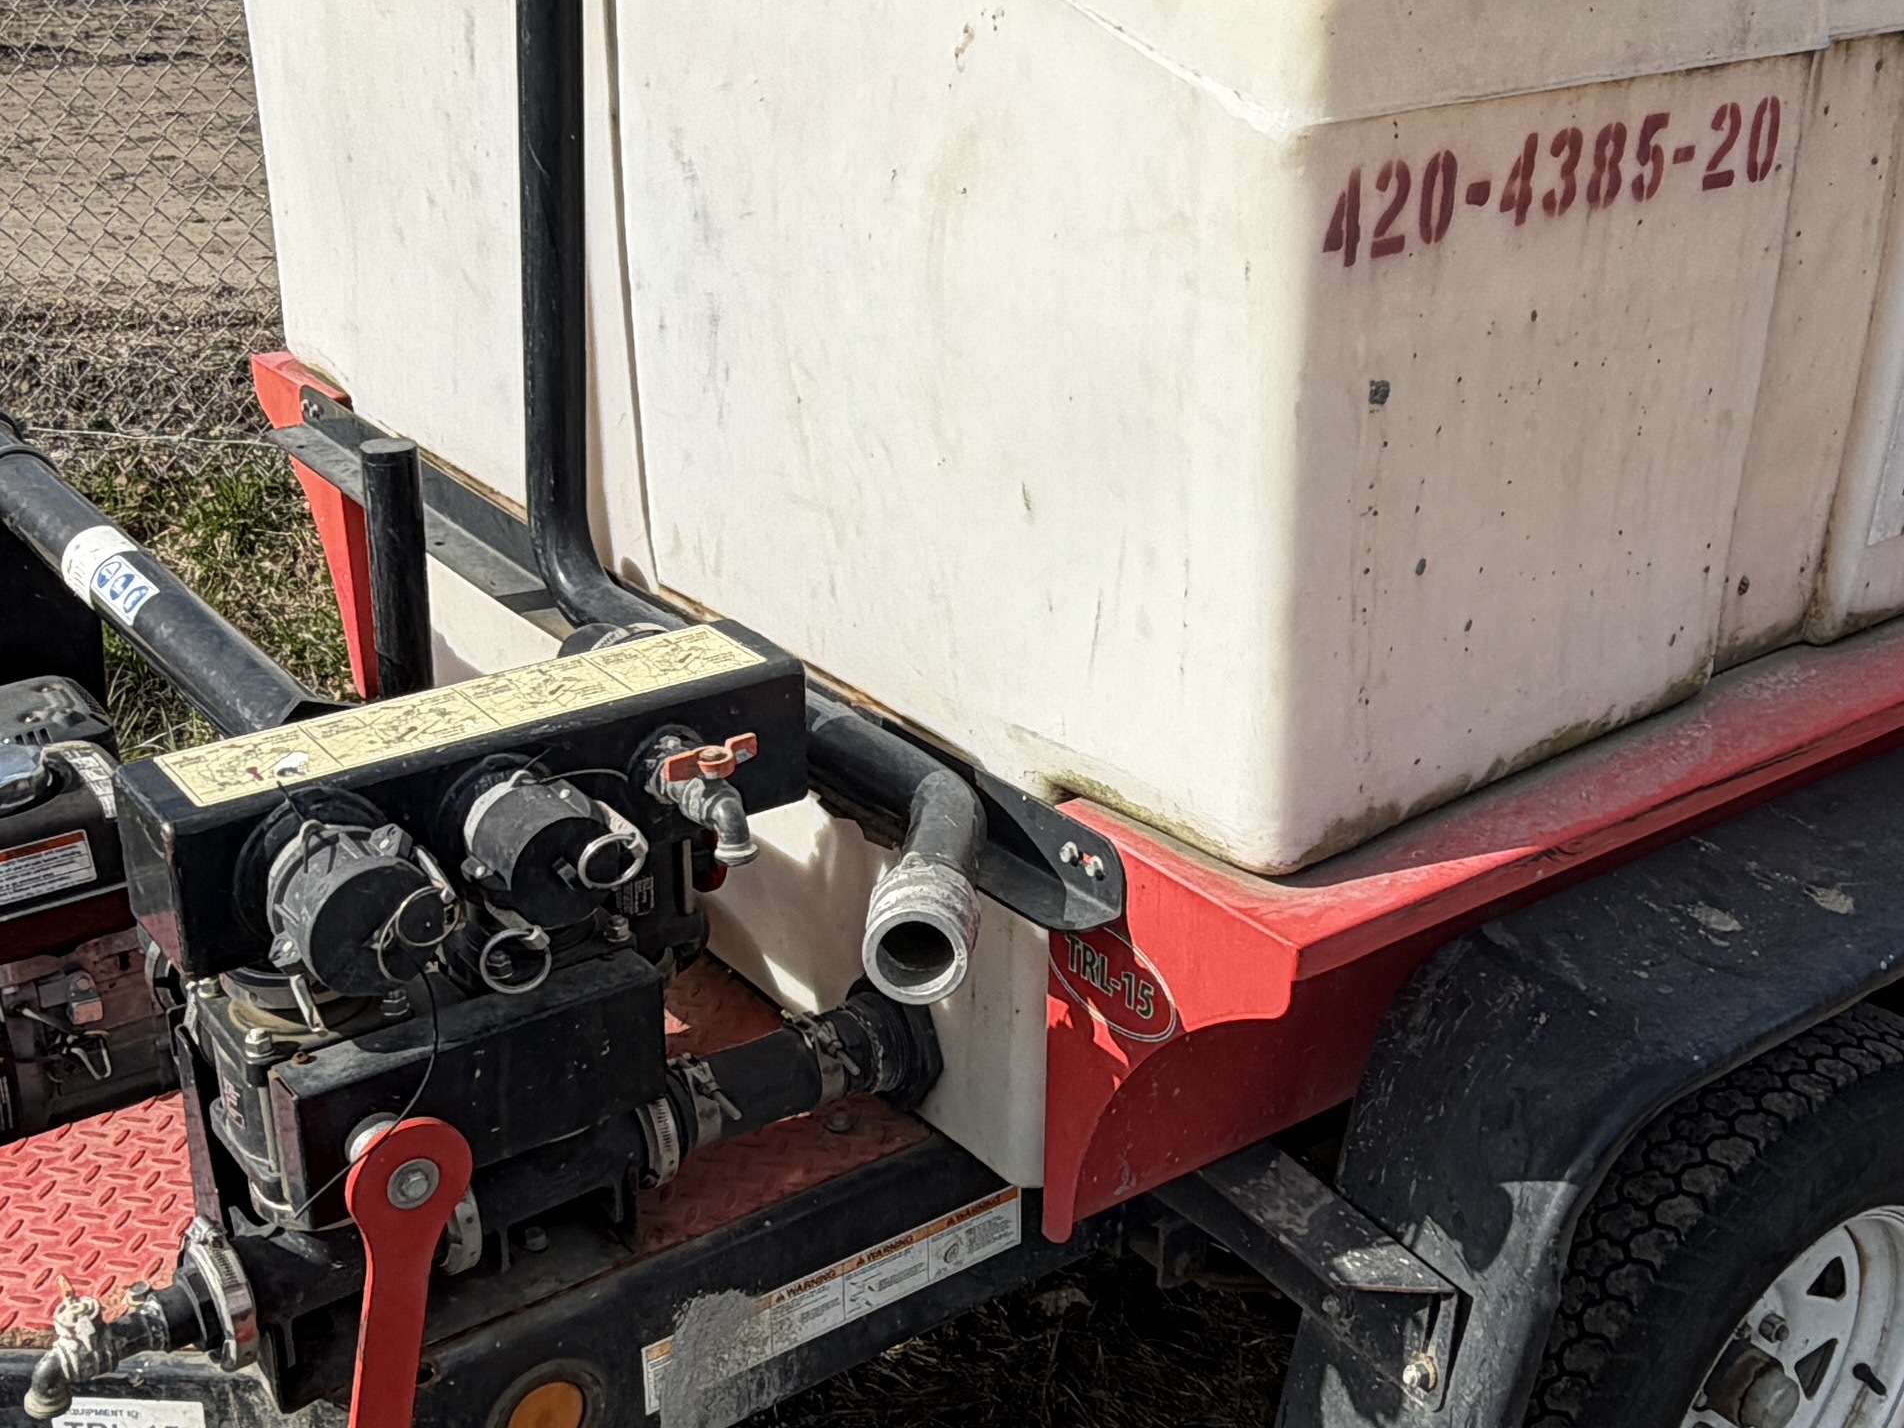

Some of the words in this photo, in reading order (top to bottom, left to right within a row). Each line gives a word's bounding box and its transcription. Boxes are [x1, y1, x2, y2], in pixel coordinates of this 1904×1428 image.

[1321, 95, 1782, 268] 420-4385-20
[1064, 933, 1155, 1020] TRL-15
[785, 1268, 837, 1299] WARNING
